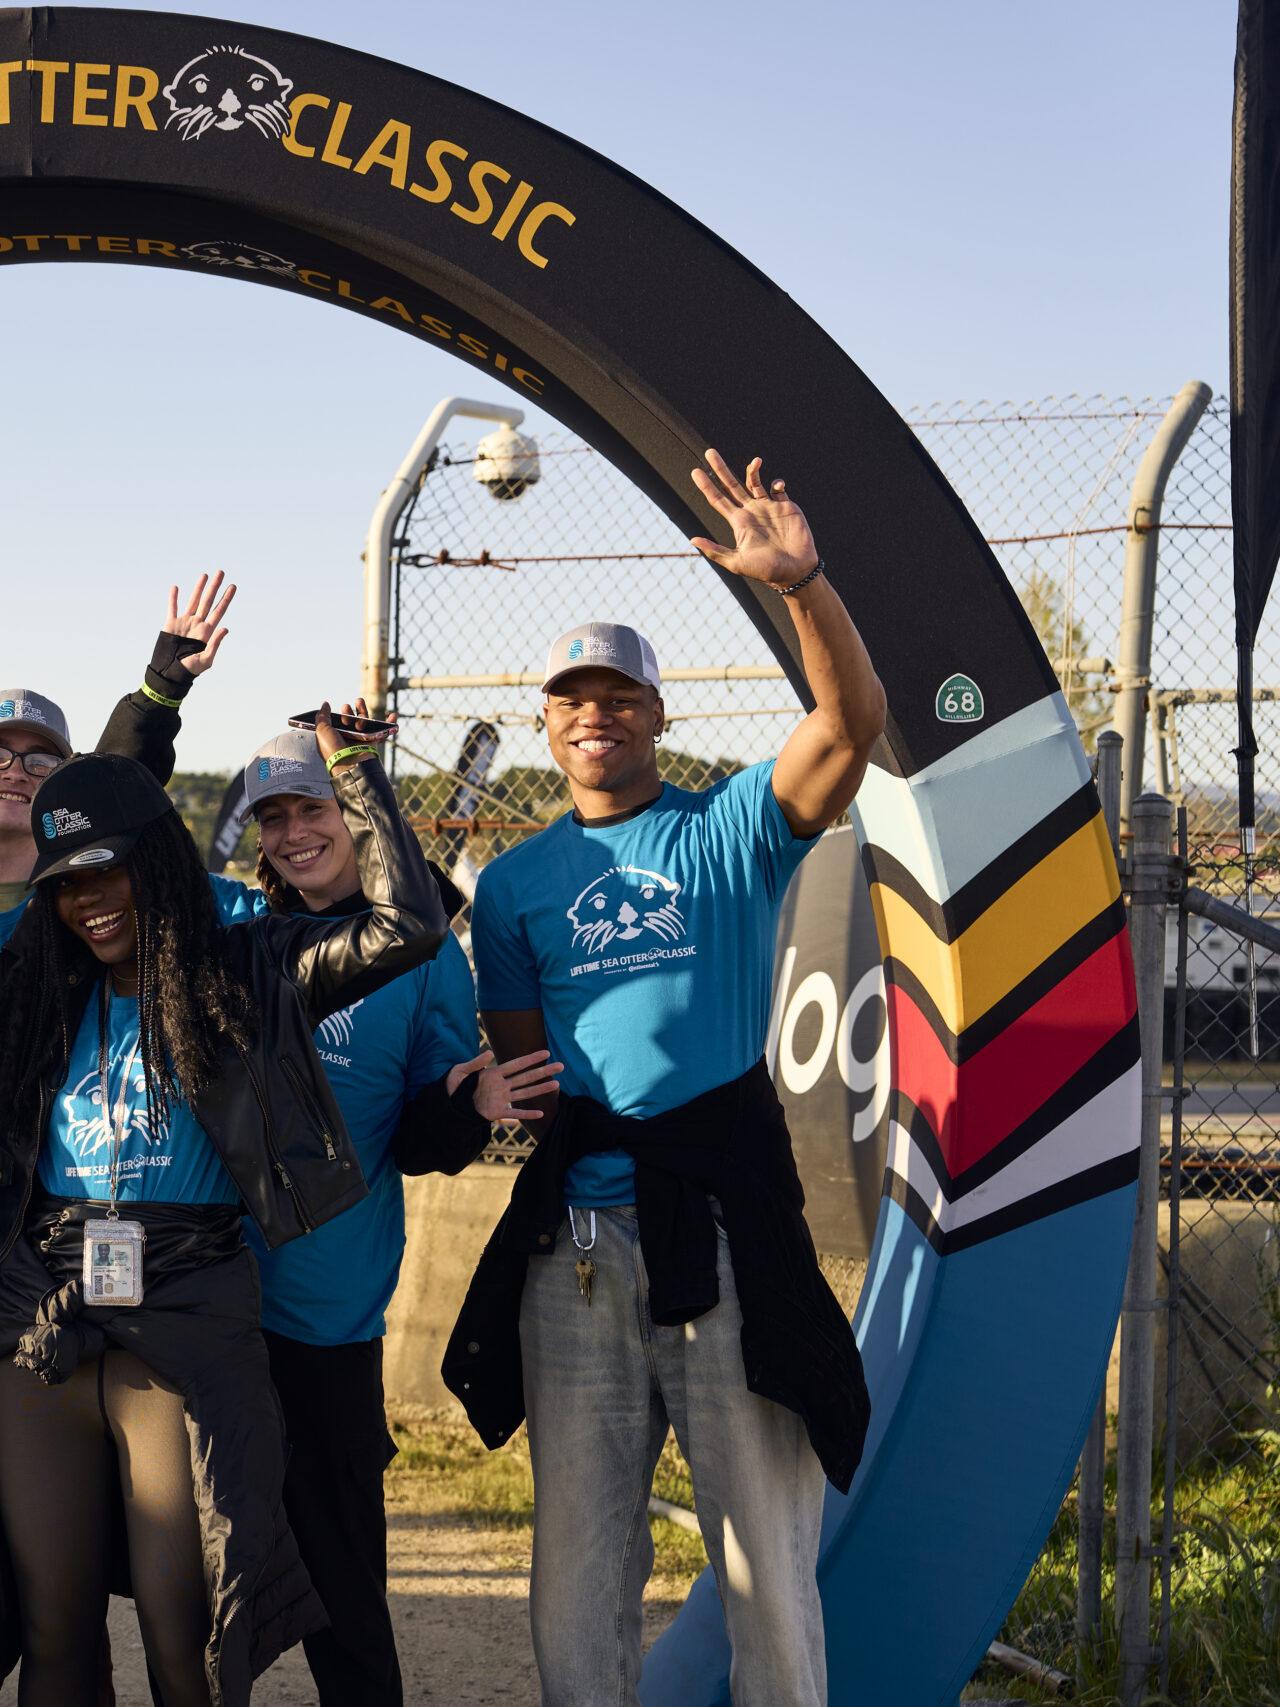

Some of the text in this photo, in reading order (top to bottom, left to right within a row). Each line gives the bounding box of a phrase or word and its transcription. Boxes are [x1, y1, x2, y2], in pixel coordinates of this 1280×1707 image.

[282, 94, 577, 269] CLASSIC
[296, 269, 545, 395] CLASSIC
[944, 691, 975, 713] 68
[53, 808, 69, 818] SEA
[54, 811, 82, 825] OTTER
[56, 817, 90, 832] CLASSIC
[602, 958, 619, 968] SEA
[620, 953, 648, 965] OTTER
[661, 945, 697, 959] CLASSIC
[93, 1165, 110, 1176] SEA
